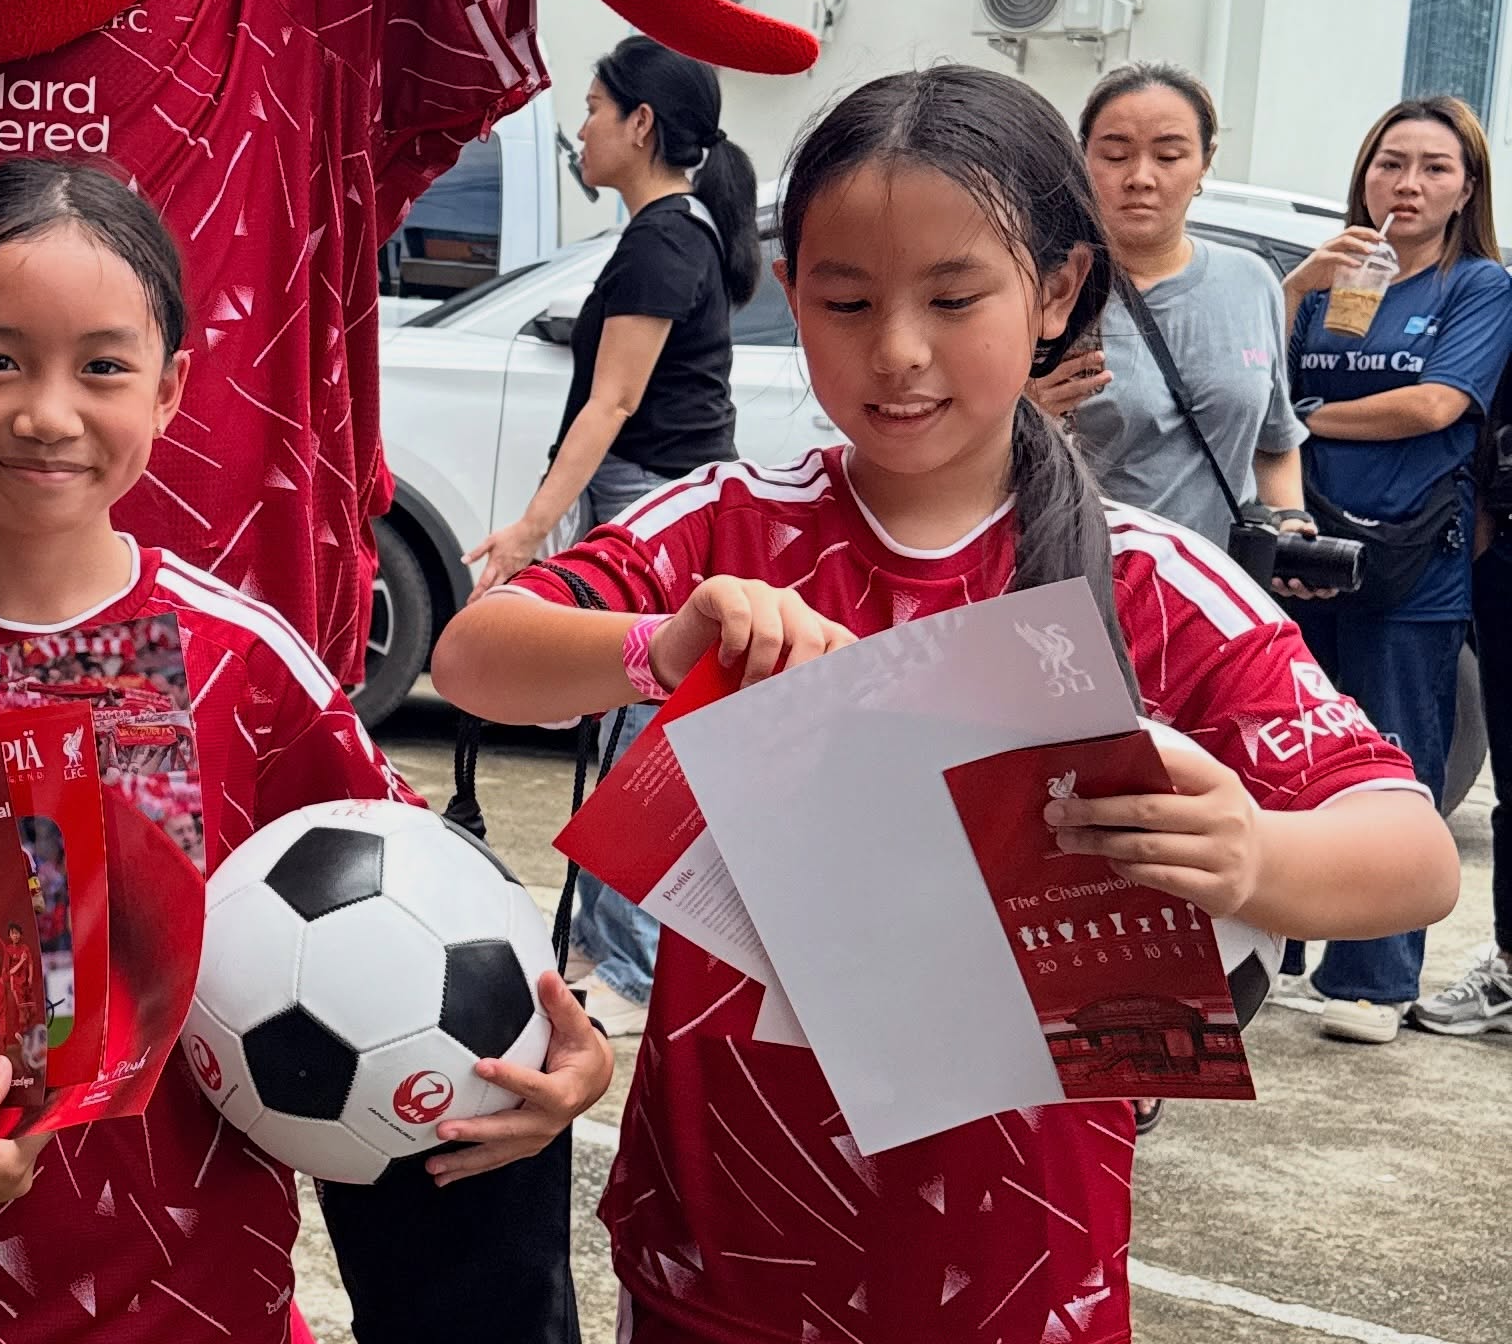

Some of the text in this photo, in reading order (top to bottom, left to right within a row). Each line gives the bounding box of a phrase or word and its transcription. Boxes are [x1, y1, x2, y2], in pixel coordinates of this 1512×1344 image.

[1346, 350, 1386, 371] You
[1391, 350, 1424, 373] Ca
[1, 729, 44, 773] PIÄ
[662, 868, 695, 902] Profile
[1005, 875, 1138, 912] The Champion
[1037, 960, 1057, 974] 20
[1072, 953, 1083, 967] 6
[1096, 950, 1108, 963] 8
[1120, 947, 1132, 961] 3
[1144, 943, 1161, 959] 10
[398, 1103, 426, 1123] JAL
